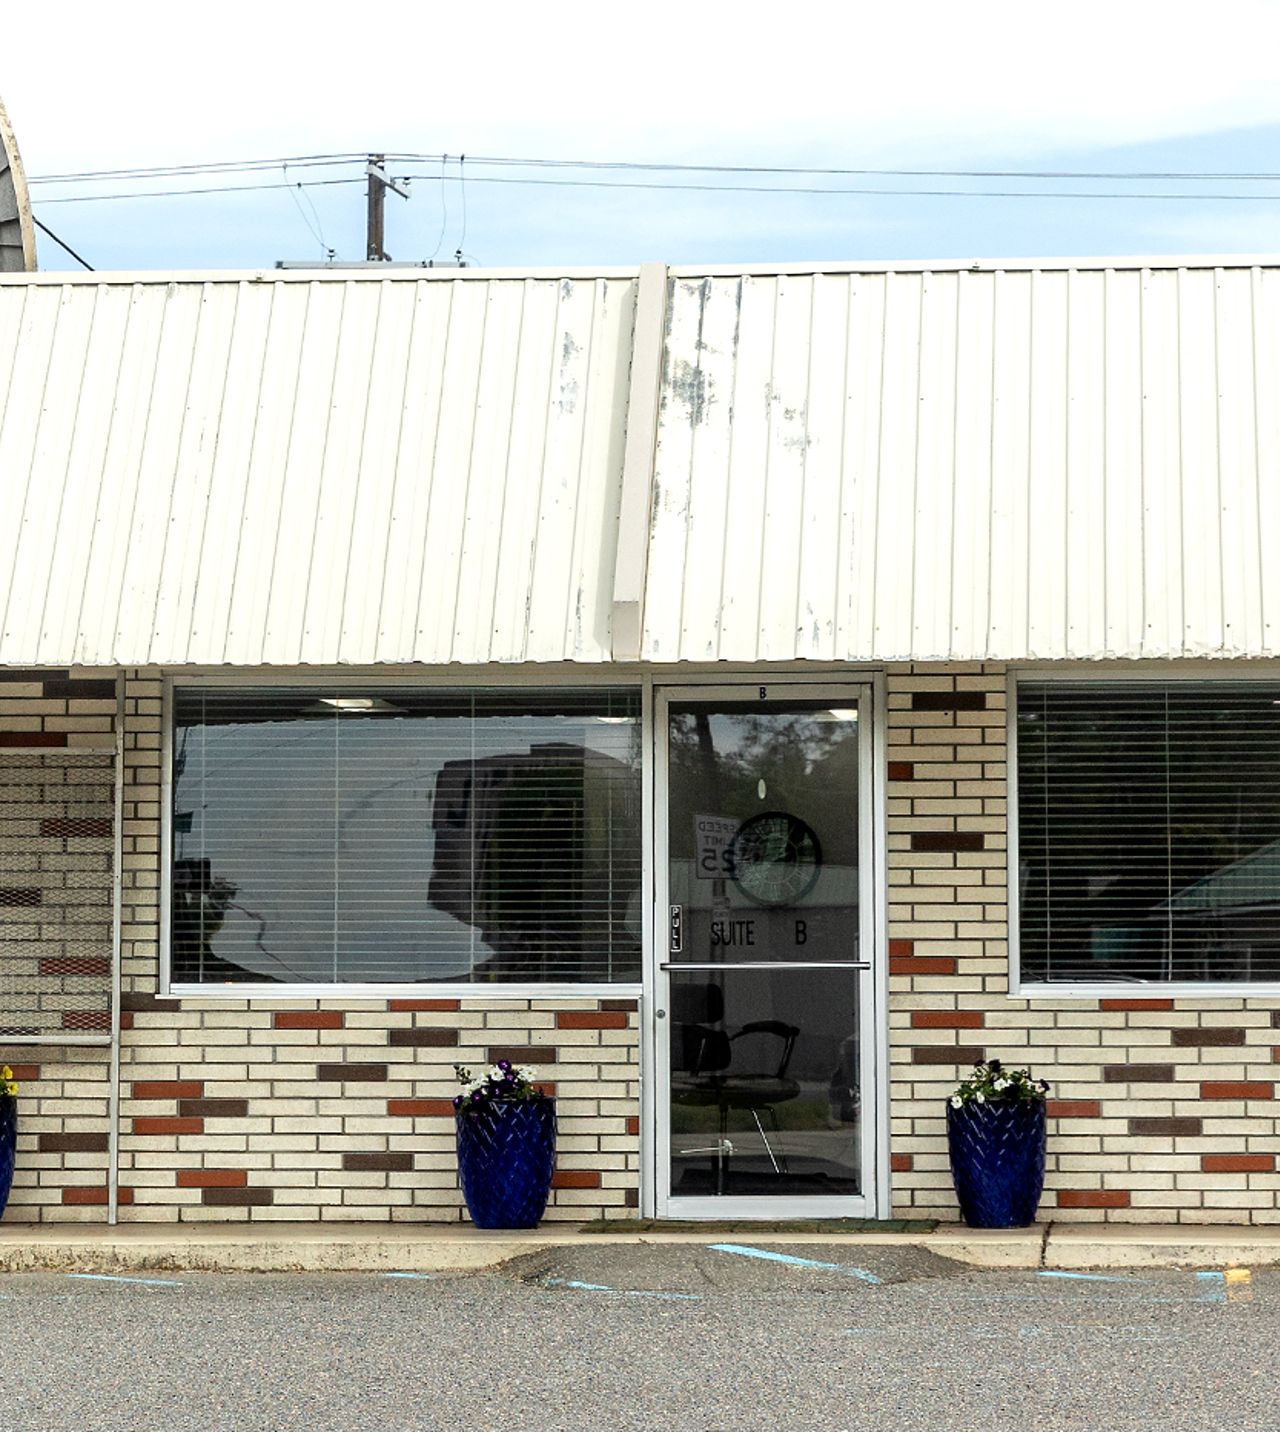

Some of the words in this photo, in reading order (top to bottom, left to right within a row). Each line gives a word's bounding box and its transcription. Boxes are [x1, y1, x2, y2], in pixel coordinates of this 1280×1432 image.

[759, 687, 767, 699] B
[672, 907, 680, 949] PULL
[710, 921, 755, 946] SUITE
[795, 920, 807, 945] B
